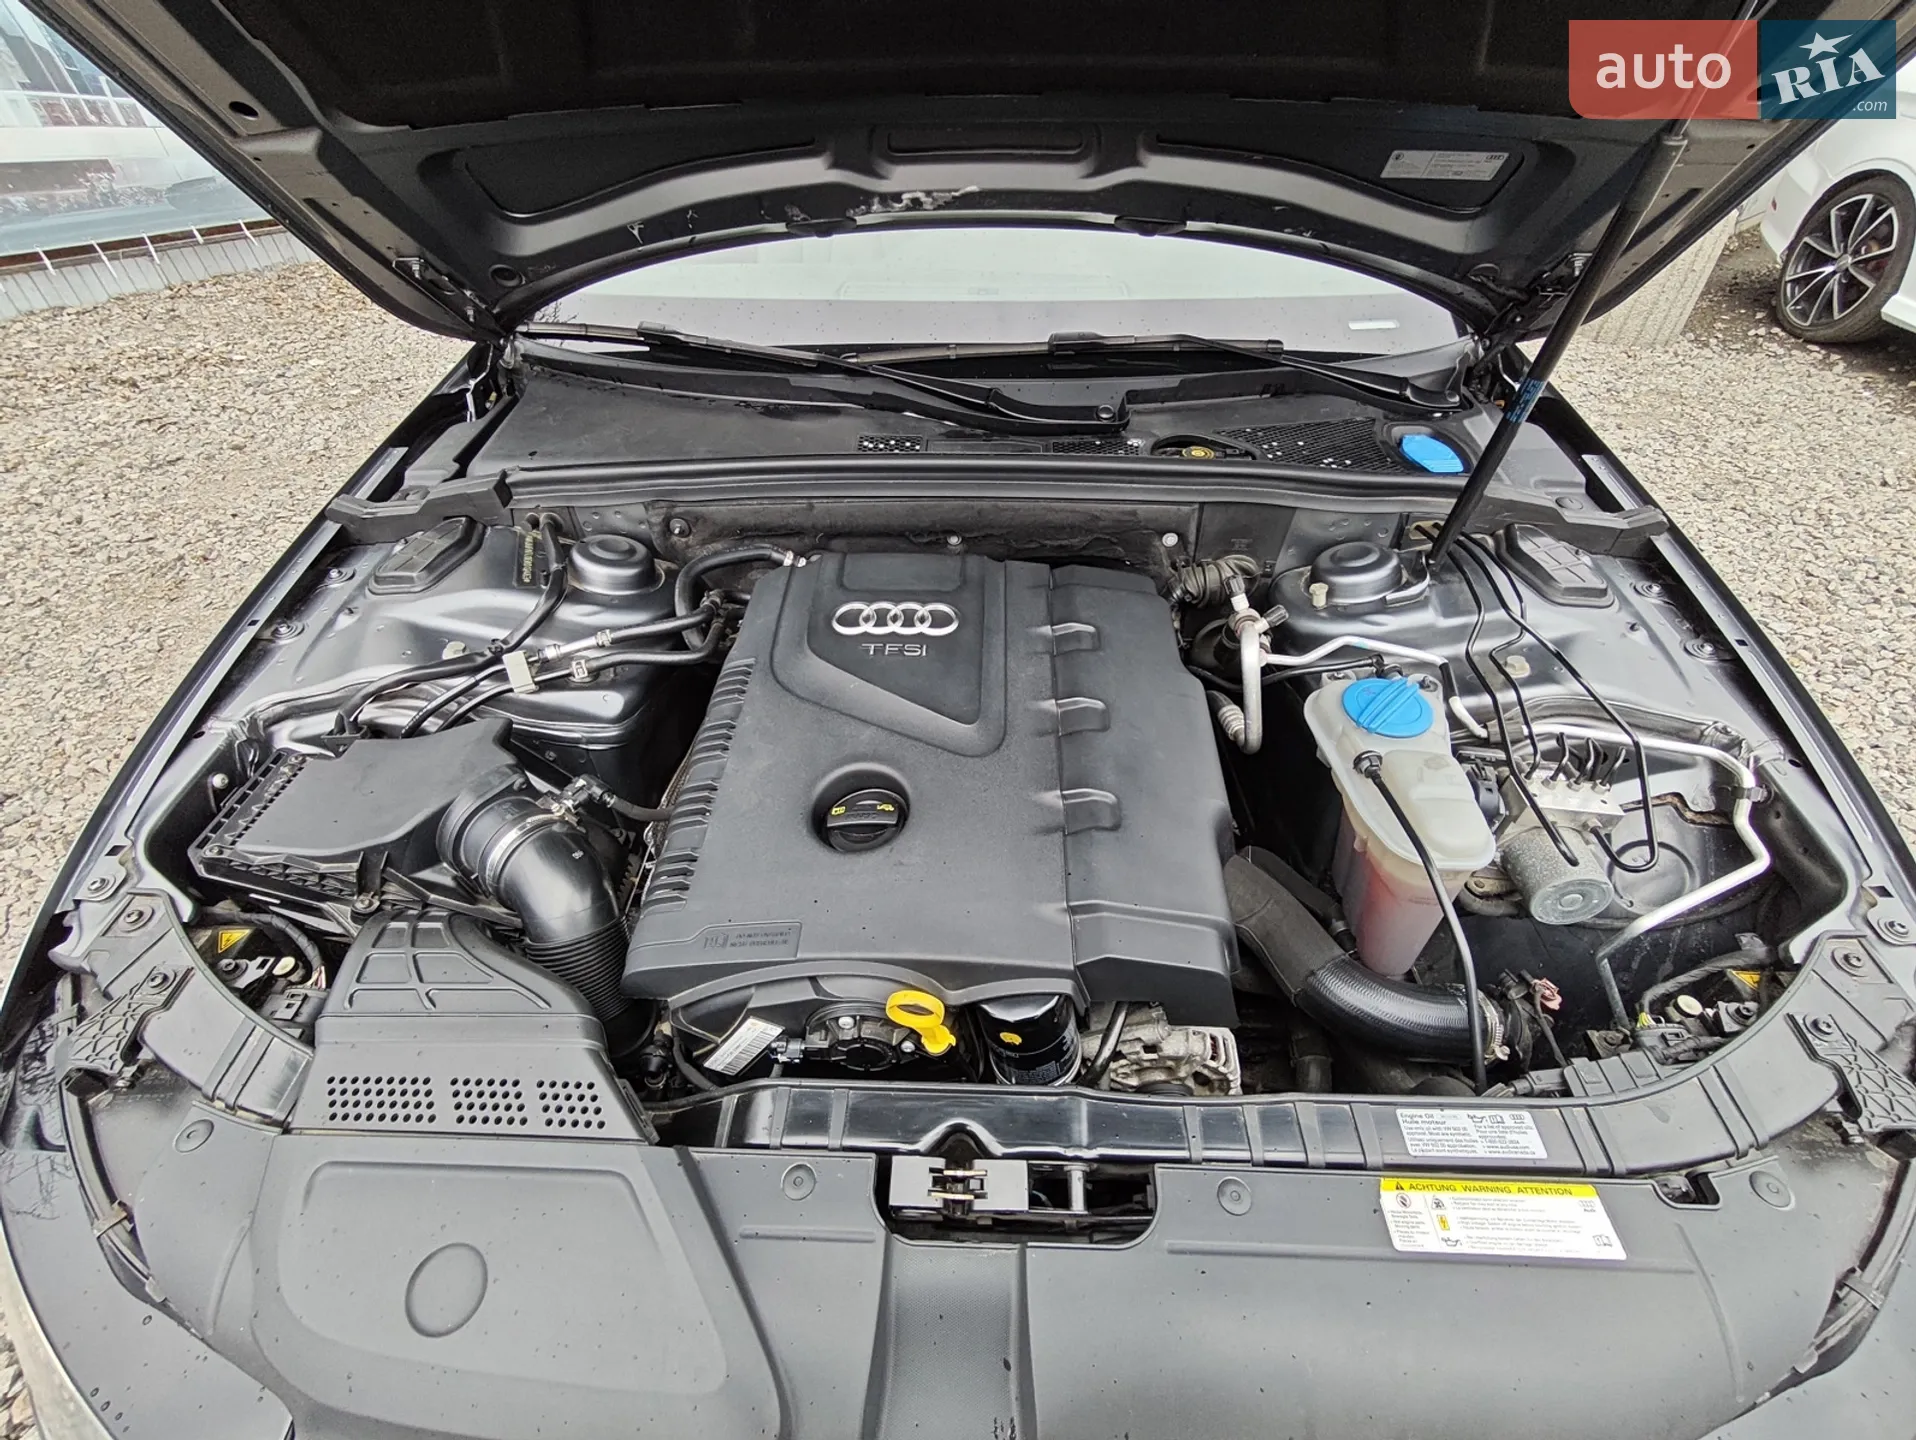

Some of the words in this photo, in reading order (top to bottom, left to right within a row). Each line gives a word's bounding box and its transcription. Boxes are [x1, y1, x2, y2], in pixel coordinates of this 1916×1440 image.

[862, 644, 926, 656] TFSI
[1409, 1183, 1457, 1192] ACHTUNG
[1462, 1185, 1512, 1194] WARNING
[1517, 1186, 1573, 1196] ATTENTION
